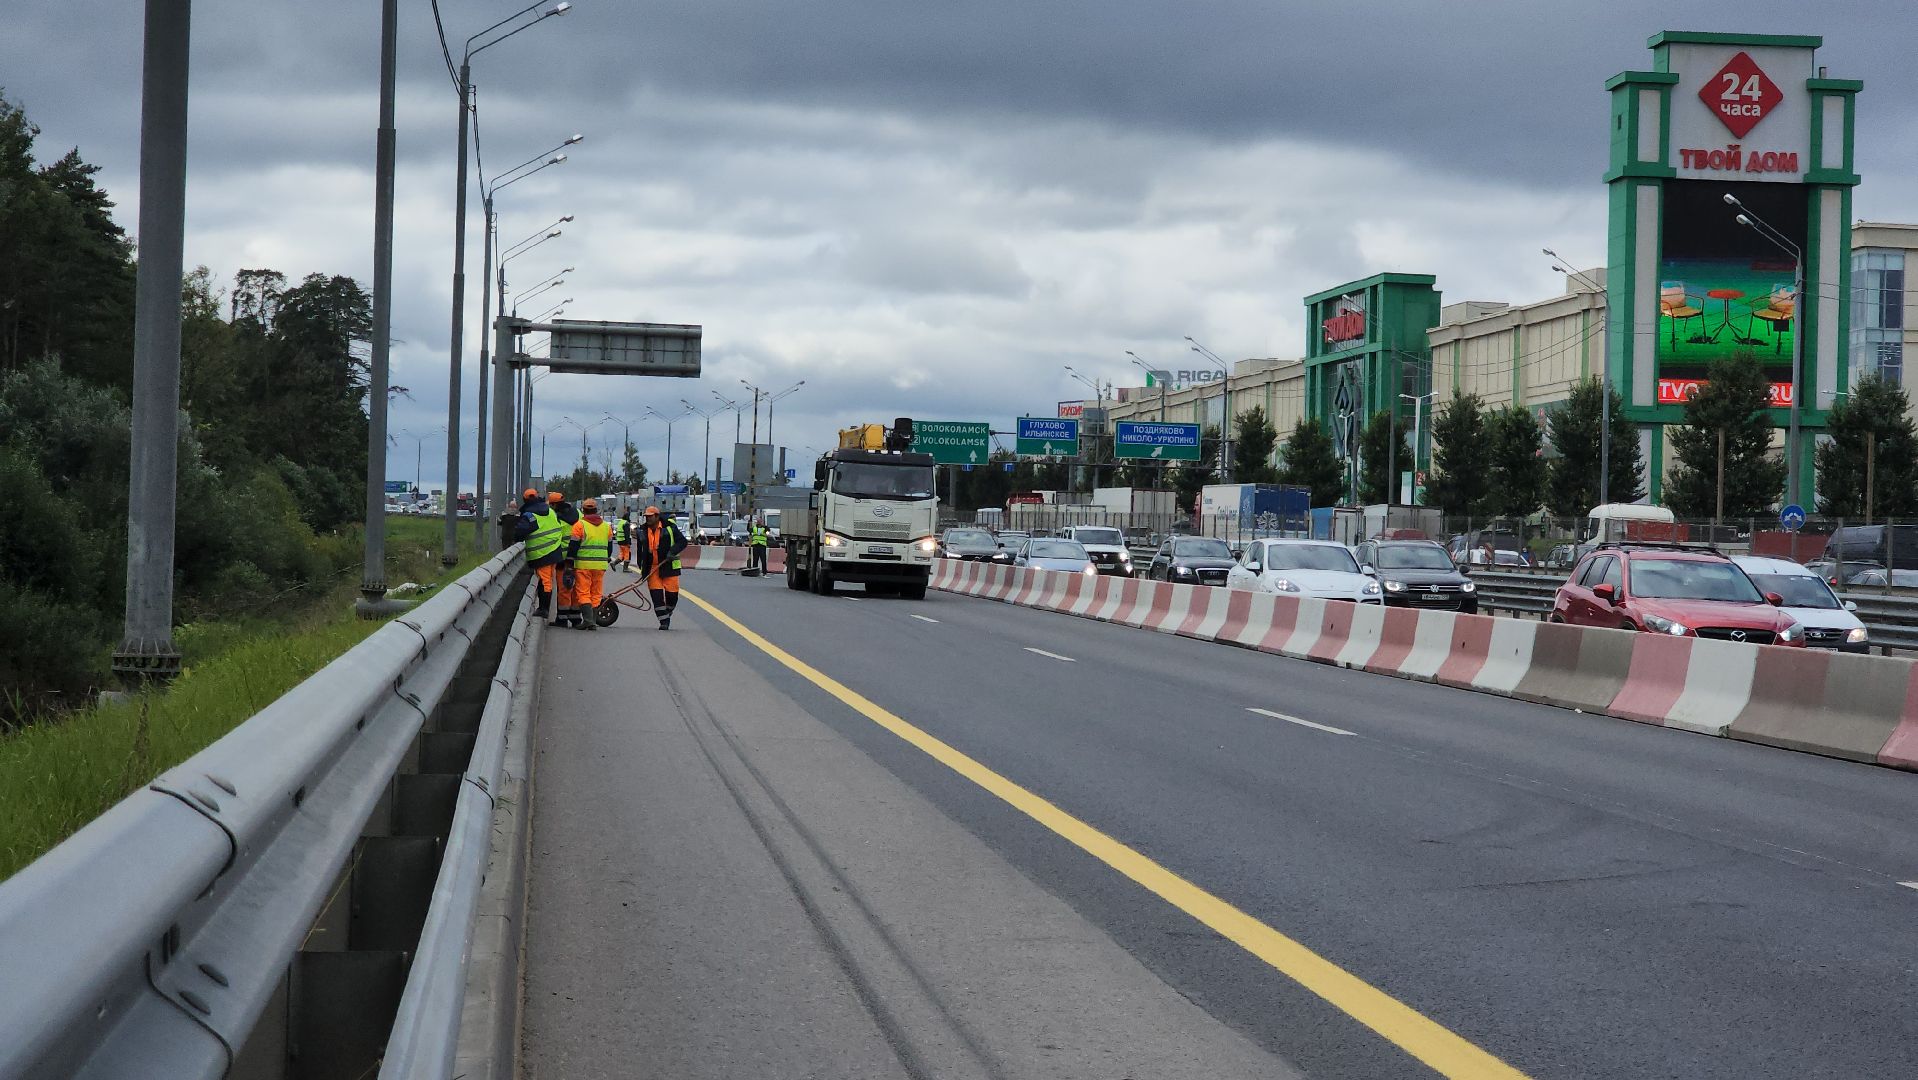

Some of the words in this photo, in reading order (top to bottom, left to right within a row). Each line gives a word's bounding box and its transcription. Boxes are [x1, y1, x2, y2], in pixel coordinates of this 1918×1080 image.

[1721, 73, 1761, 101] 24
[1721, 103, 1760, 116] часа
[1680, 144, 1741, 170] ТВОЙ
[1746, 151, 1798, 173] ДОМ
[1178, 370, 1225, 381] RIGA
[922, 424, 986, 434] ВОЛОКОЛАМСК
[1029, 421, 1065, 430] ГЛУХОВО
[1133, 425, 1184, 435] ПОЗДНЯКОВО
[1025, 430, 1070, 438] ИЛЬИНСКОЕ
[922, 437, 985, 446] VOLOKOLAMSK
